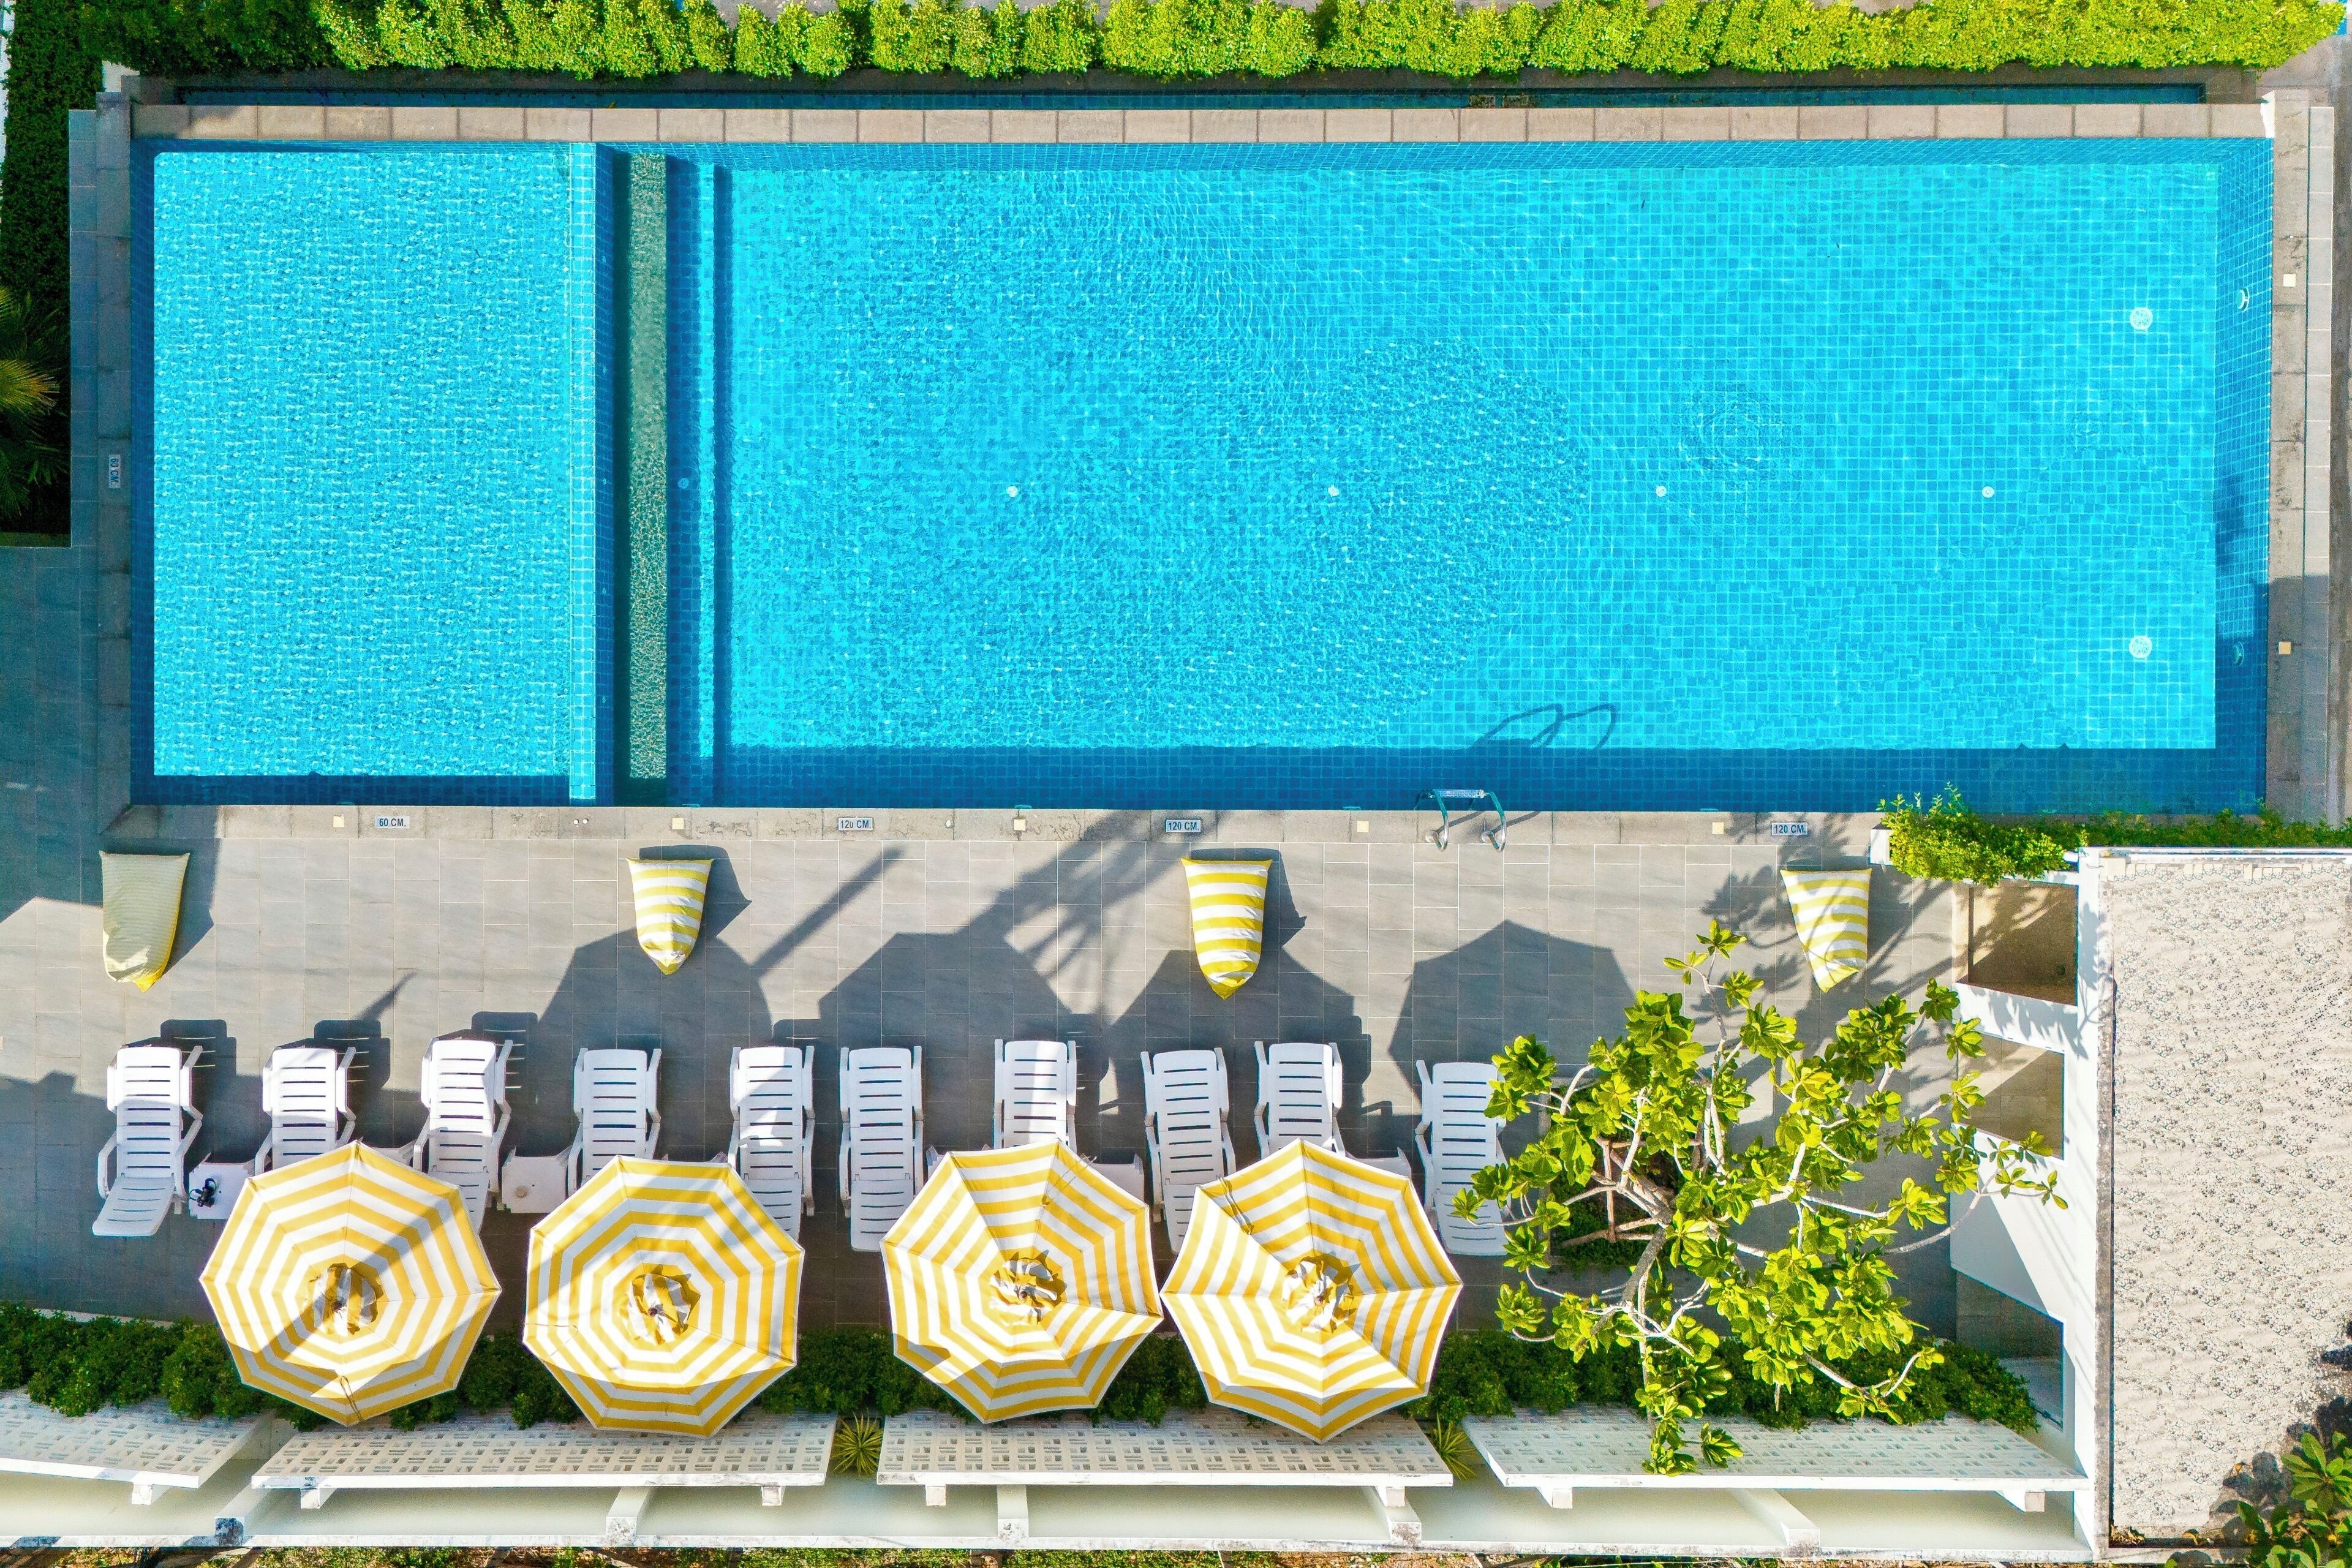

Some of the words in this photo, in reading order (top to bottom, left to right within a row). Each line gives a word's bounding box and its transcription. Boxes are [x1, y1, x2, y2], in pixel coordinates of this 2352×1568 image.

[110, 458, 119, 467] 60
[379, 818, 388, 827] 60
[391, 818, 406, 827] CM.
[840, 820, 854, 829] 120
[856, 820, 871, 829] CM.
[1168, 822, 1182, 831] 120
[1184, 822, 1199, 831] CM.
[1774, 824, 1788, 834] 120
[1790, 824, 1806, 834] CM.
